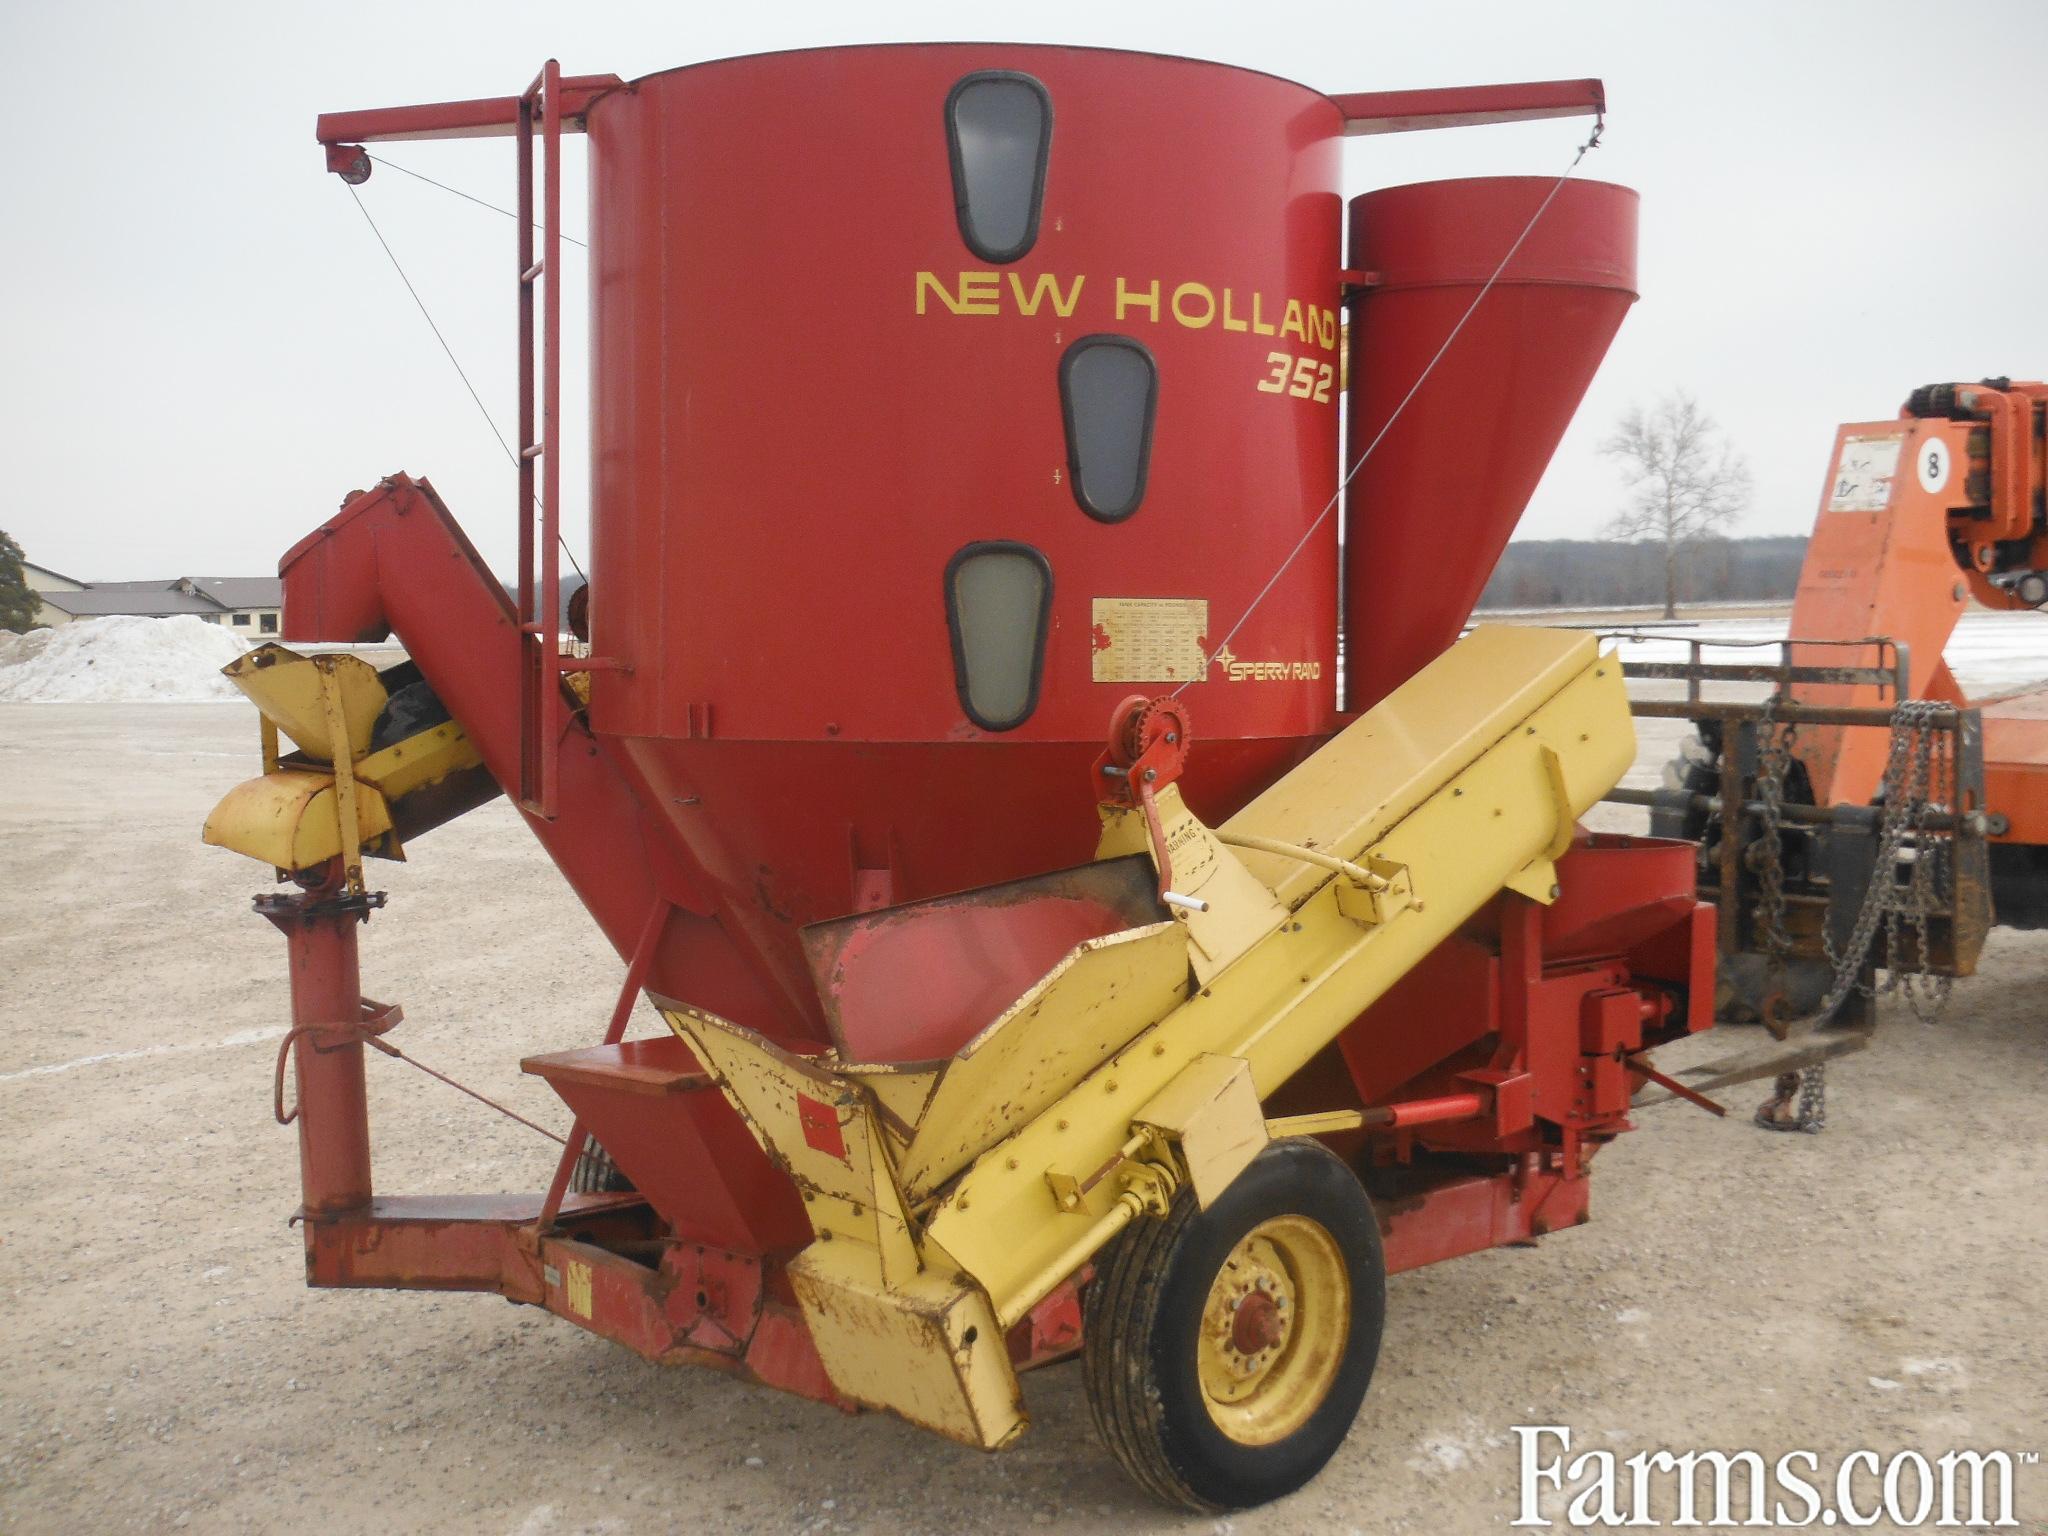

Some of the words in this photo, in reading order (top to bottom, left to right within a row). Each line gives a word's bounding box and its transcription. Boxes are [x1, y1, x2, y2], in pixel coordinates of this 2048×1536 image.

[916, 271, 1085, 317] NEW
[1115, 277, 1335, 351] HOLLAND
[1257, 351, 1334, 404] 352
[1928, 452, 1939, 479] 8
[1228, 662, 1291, 682] SPERRY
[1292, 662, 1321, 681] RAND
[1167, 828, 1197, 855] ARNING
